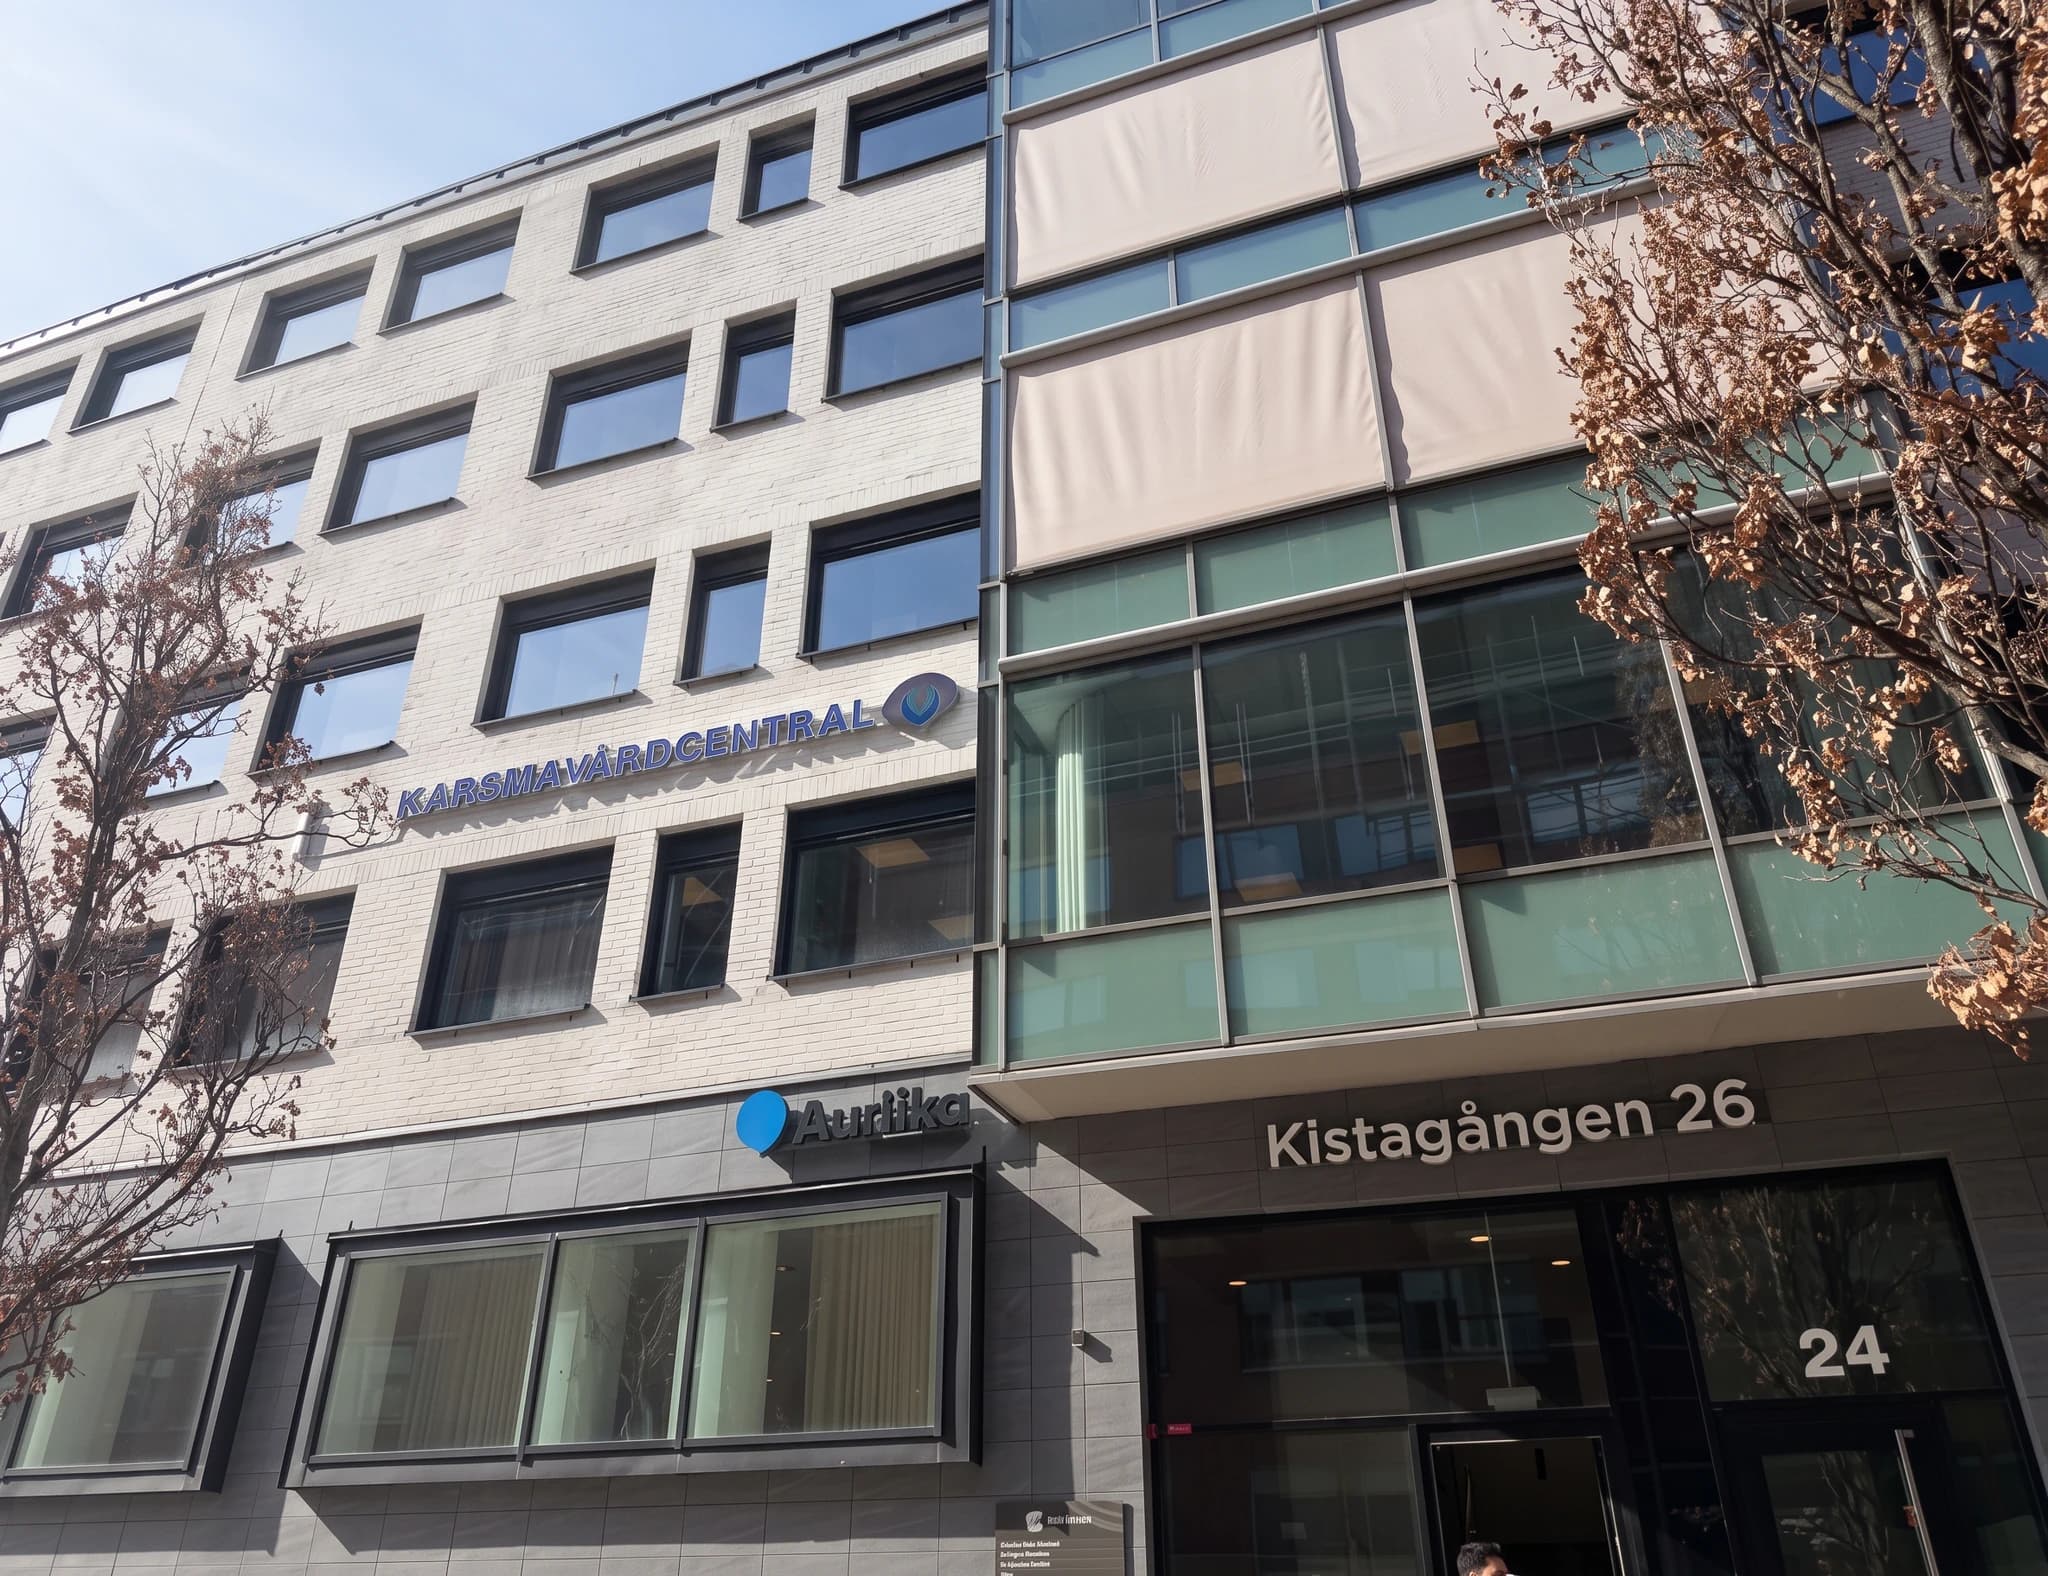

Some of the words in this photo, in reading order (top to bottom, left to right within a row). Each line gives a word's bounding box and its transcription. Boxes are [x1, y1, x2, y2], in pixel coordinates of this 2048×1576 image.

[1266, 1101, 1654, 1165] Kistagången
[1670, 1079, 1755, 1134] 26
[1799, 1325, 1890, 1378] 24
